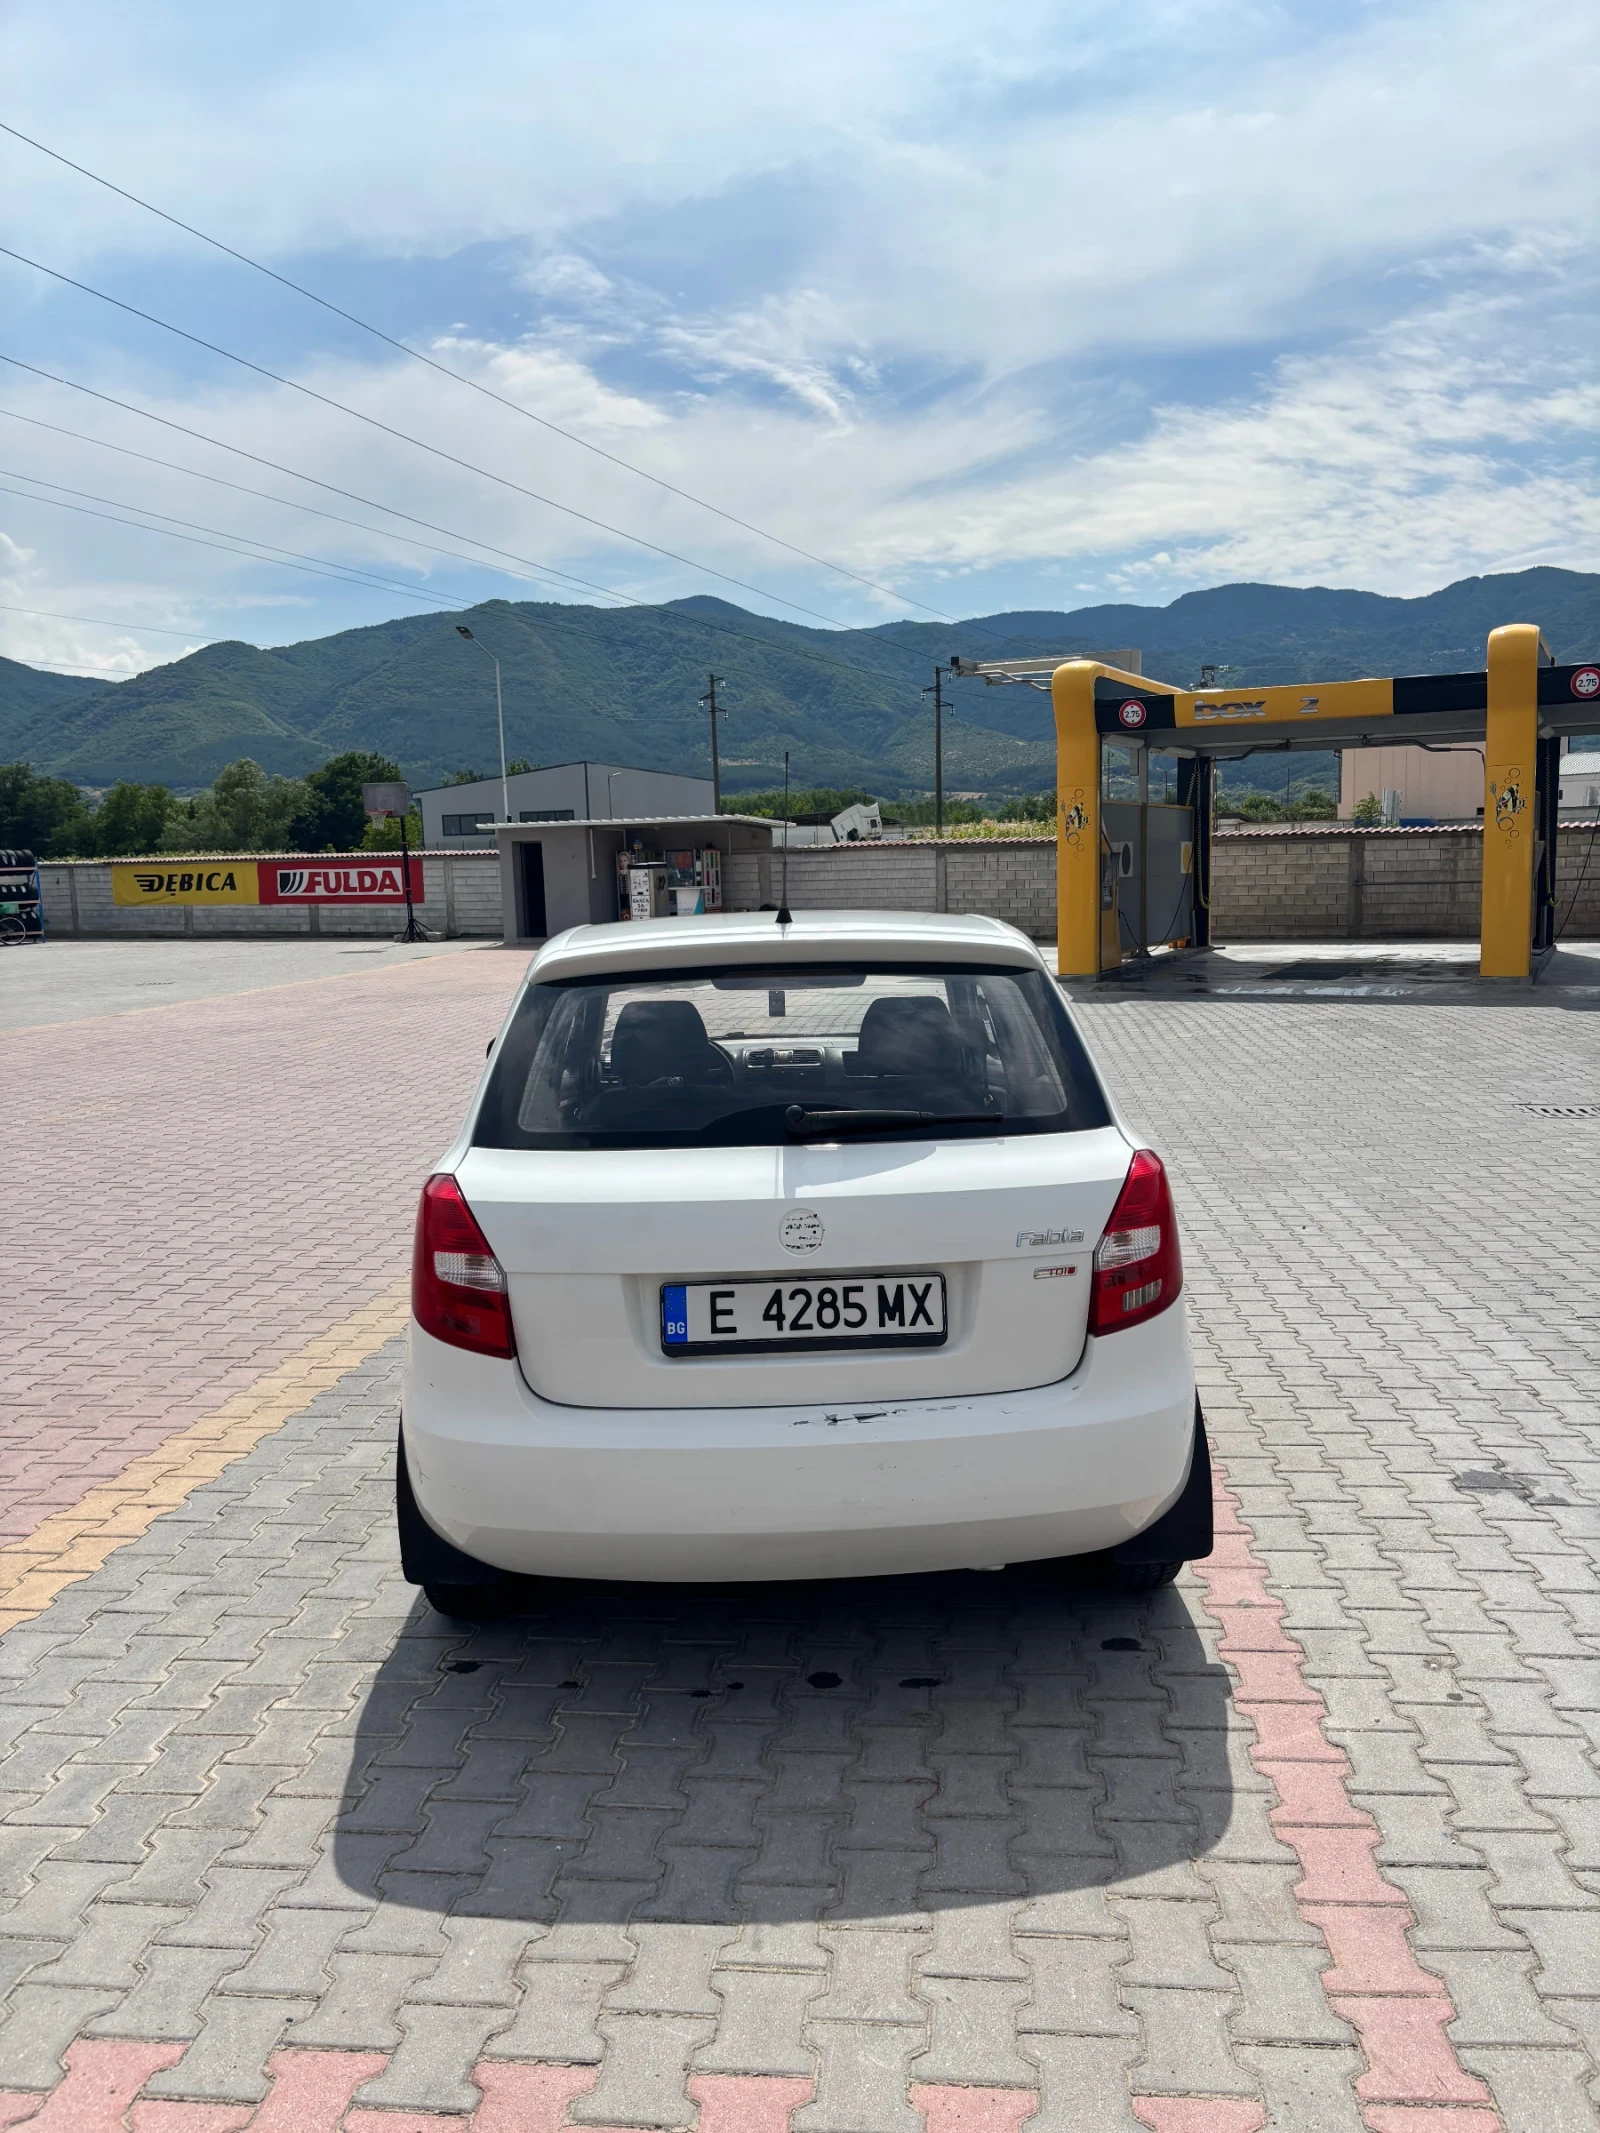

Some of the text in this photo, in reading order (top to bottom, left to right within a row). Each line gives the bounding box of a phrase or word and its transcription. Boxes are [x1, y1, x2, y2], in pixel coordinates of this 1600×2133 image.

[1577, 678, 1598, 688] 2.75
[1124, 710, 1141, 719] 2.75
[1194, 696, 1320, 720] box 2
[302, 870, 402, 894] FULDA
[1016, 1228, 1084, 1248] Fabia
[1048, 1266, 1067, 1276] TDI
[709, 1283, 935, 1334] E 4285 MX
[667, 1321, 686, 1335] BG
